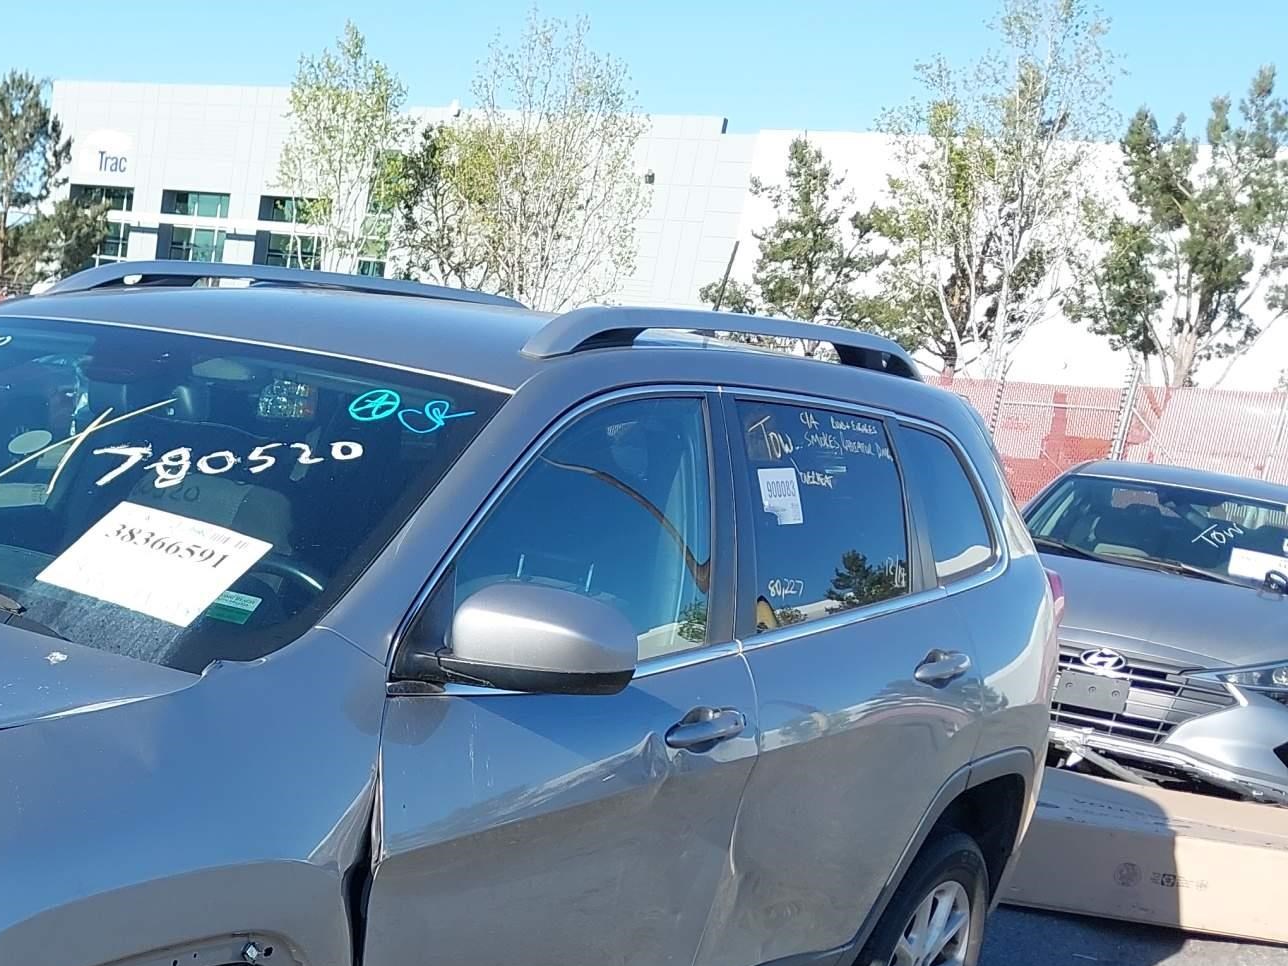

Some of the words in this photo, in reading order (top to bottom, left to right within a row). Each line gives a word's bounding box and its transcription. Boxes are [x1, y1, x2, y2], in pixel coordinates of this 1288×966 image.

[98, 150, 127, 173] Trac
[93, 440, 364, 489] 780520
[105, 523, 230, 569] 38366591
